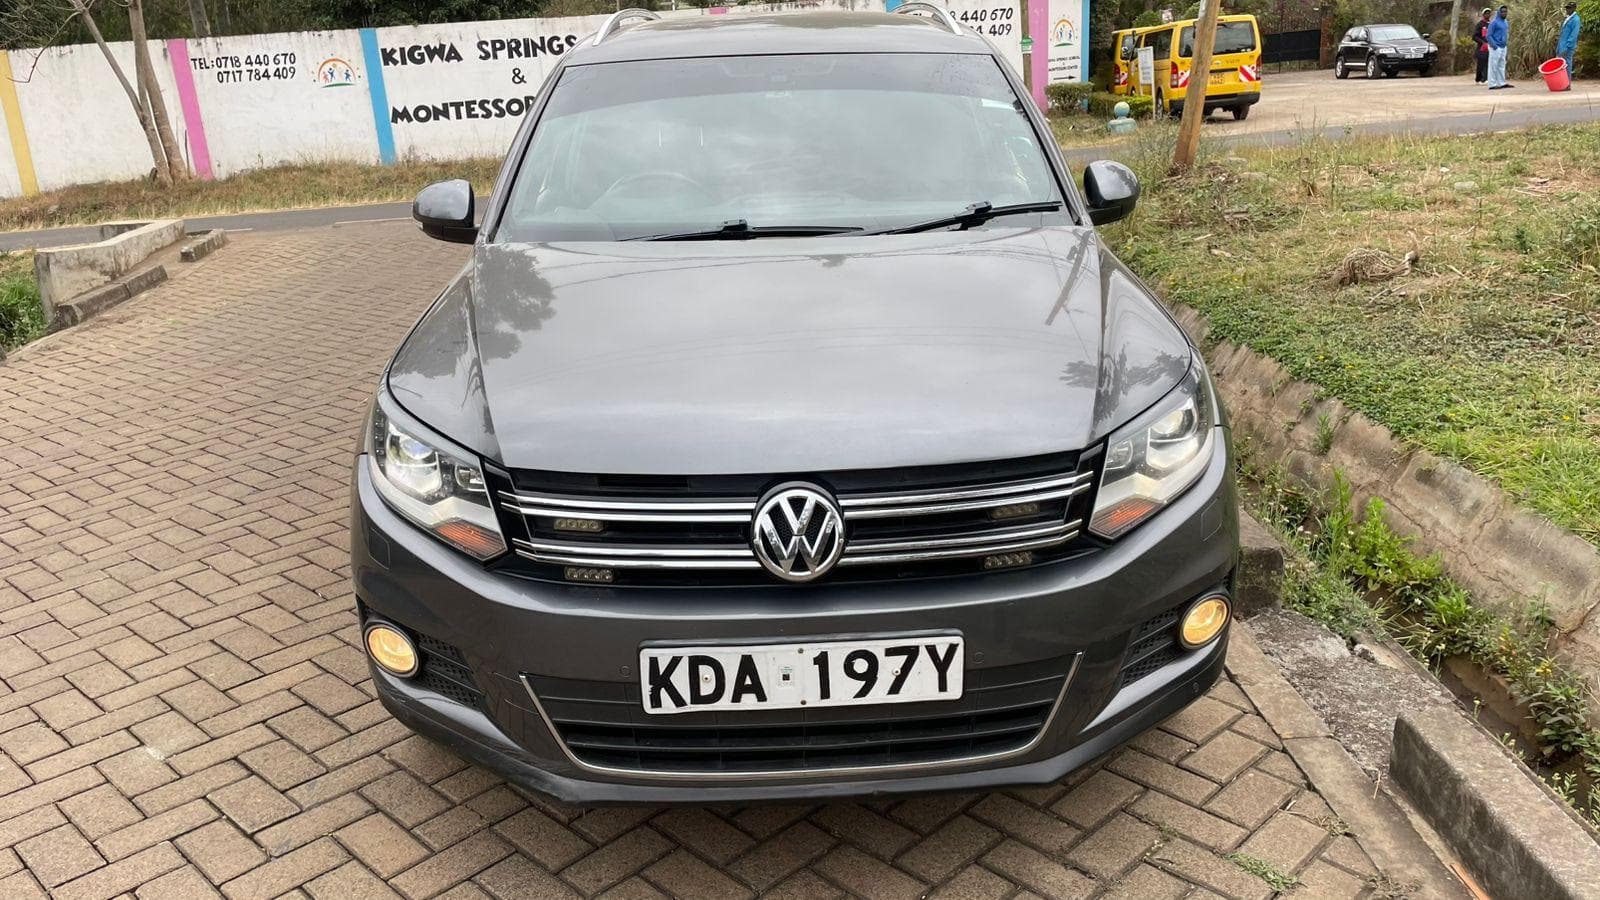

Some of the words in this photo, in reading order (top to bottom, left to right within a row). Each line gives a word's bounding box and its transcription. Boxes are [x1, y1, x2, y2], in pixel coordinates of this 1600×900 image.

[960, 9, 987, 23] 440
[990, 7, 1014, 21] 670
[988, 23, 1012, 37] 409
[244, 54, 270, 67] 440
[273, 52, 297, 65] 670
[381, 44, 464, 66] KIGWA
[216, 70, 243, 83] 0717
[246, 68, 271, 82] 784
[273, 66, 297, 80] 409
[511, 67, 527, 85] &
[648, 653, 768, 709] KDA
[812, 643, 960, 701] 197Y
